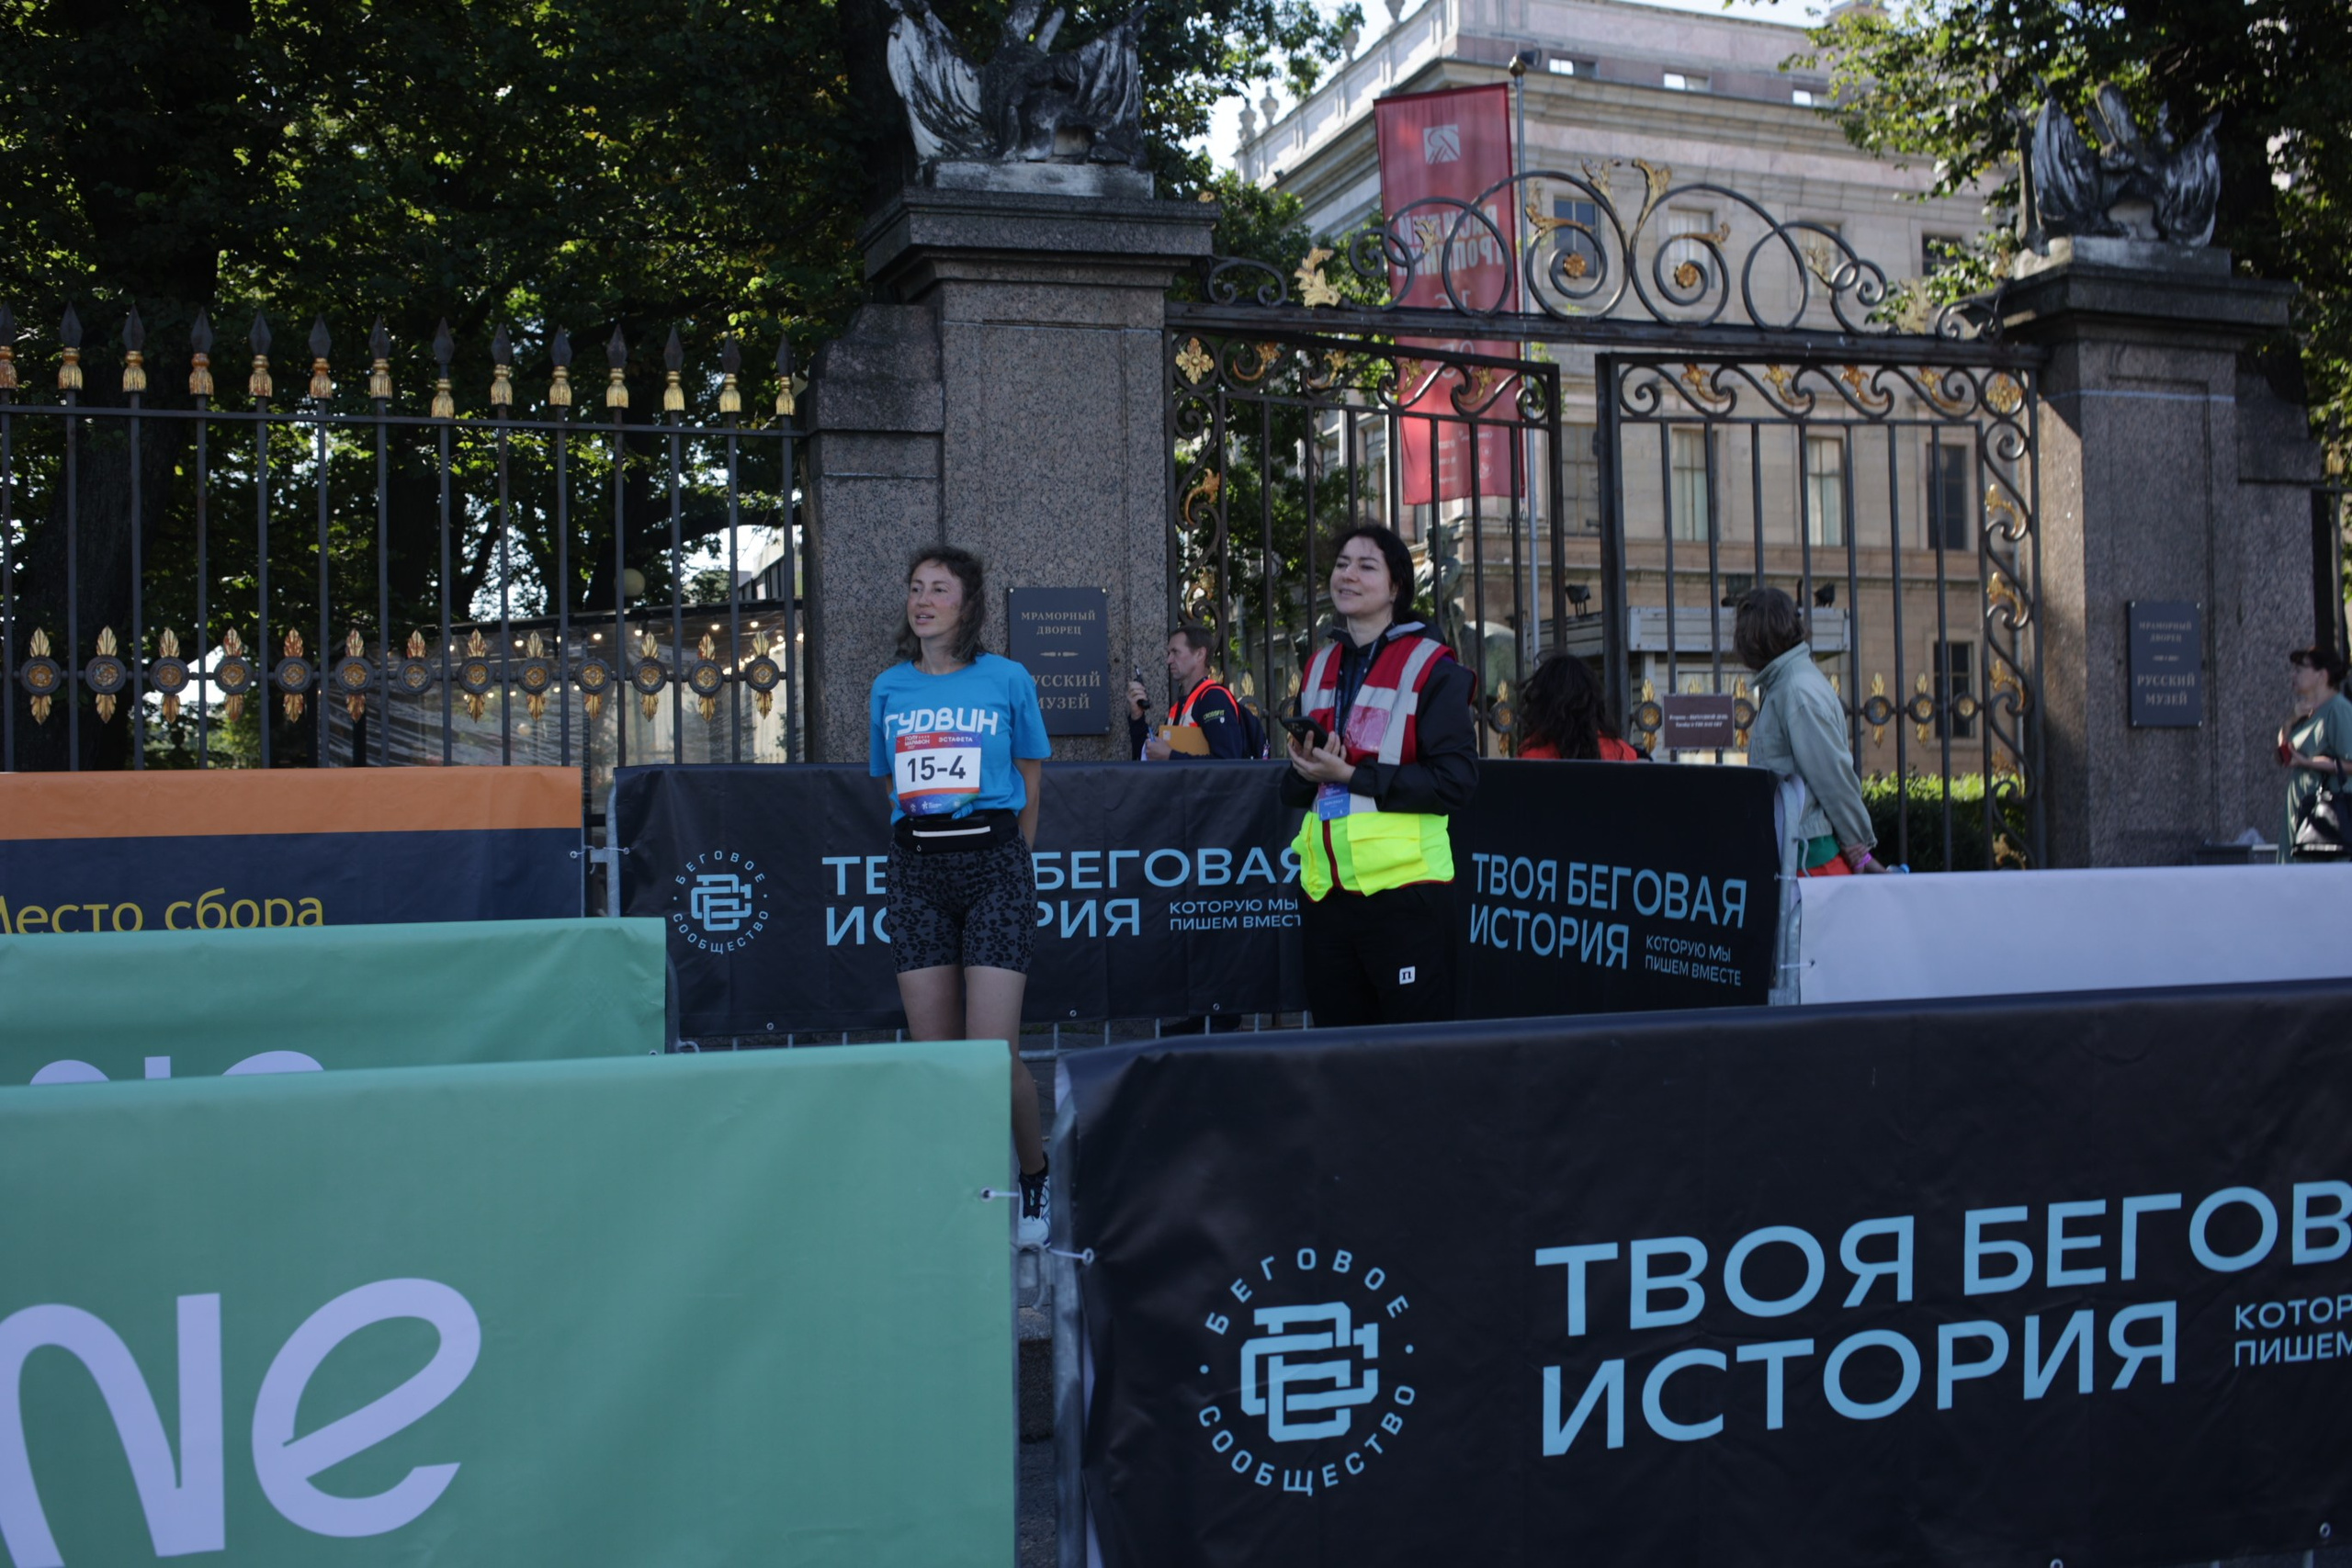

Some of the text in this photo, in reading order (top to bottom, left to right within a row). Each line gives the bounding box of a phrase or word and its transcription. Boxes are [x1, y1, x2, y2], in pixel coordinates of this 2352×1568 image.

[1022, 610, 1096, 621] МРАМОРНЫЙ
[1036, 626, 1081, 636] ДВОРЕЦ
[1031, 671, 1101, 687] УССКИЙ
[2137, 671, 2195, 687] РУССКИЙ
[2145, 691, 2188, 705] МУЗЕЙ
[908, 755, 966, 783] 15-4
[675, 850, 765, 885] БЕГОВОЕ
[1170, 897, 1298, 914] КОТОРУЮ МЫ
[1472, 852, 1747, 929] ТВОЯ БЕГОВАЯ
[673, 910, 769, 954] СООБЩЕСТВО
[1170, 914, 1301, 931] ПИШЕМ ВМЕСТ
[1470, 904, 1630, 970] ИСТОРИЯ
[1645, 935, 1731, 963] КОТОРУЮ МЫ
[1645, 954, 1741, 987] ПИШЕМ ВМЕСТЕ
[1534, 1180, 2352, 1337] ТВОЯ БЕГОВ
[1204, 1247, 1409, 1336] БЕГОВОЕ
[2235, 1293, 2352, 1331] КОТОР
[1543, 1300, 2177, 1458] ИСТОРИЯ
[1199, 1385, 1416, 1497] СООБЩЕСТВО
